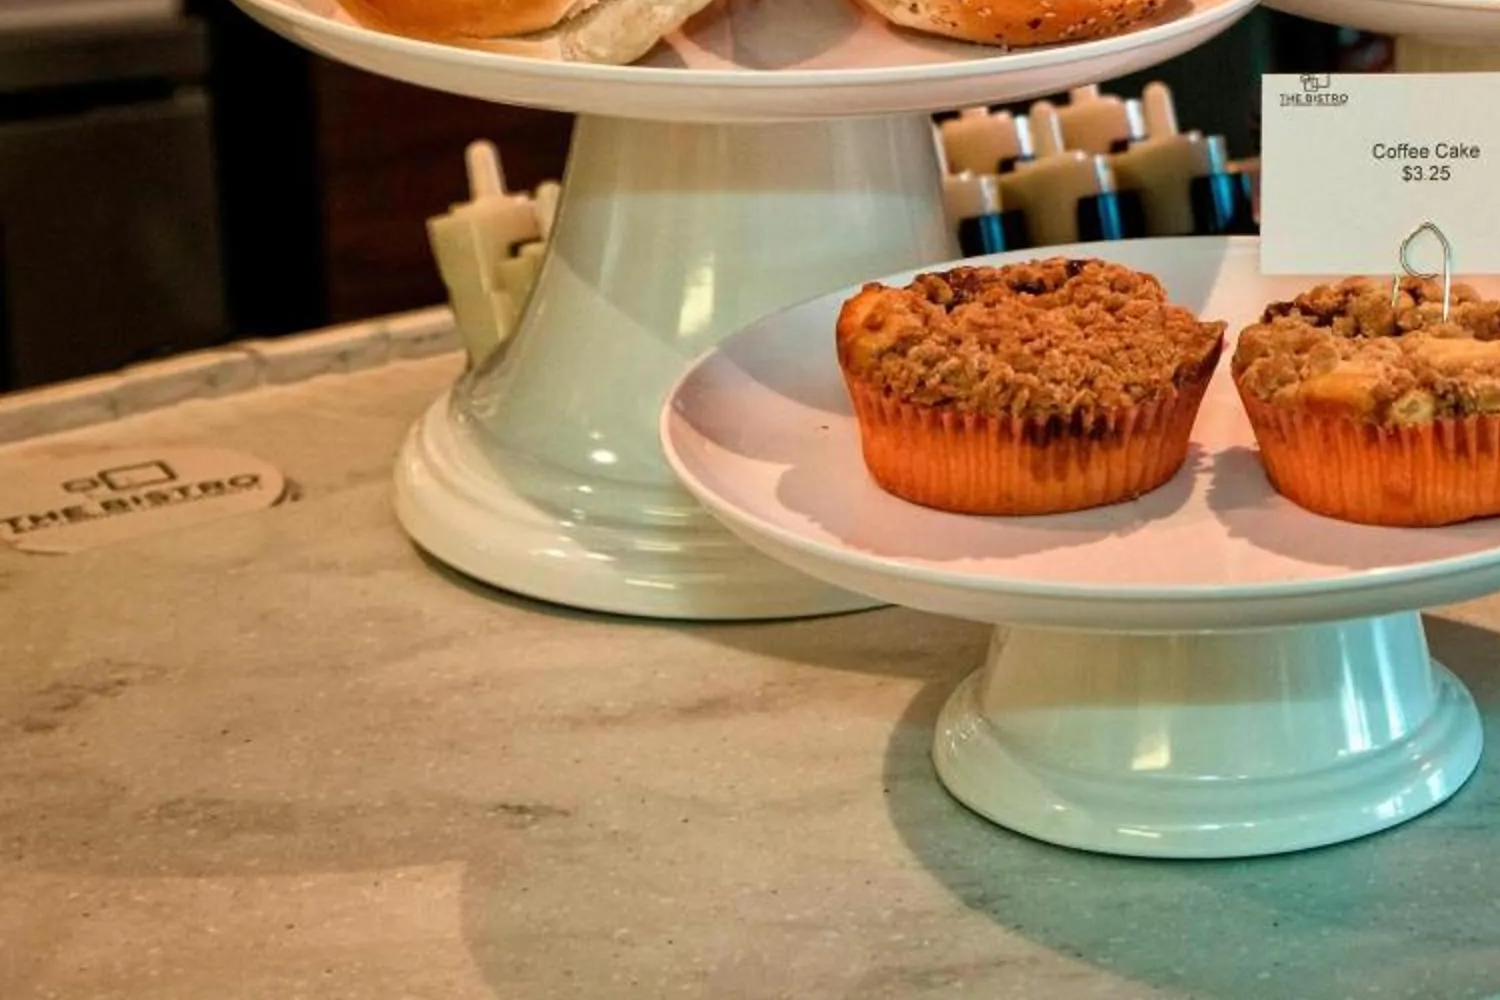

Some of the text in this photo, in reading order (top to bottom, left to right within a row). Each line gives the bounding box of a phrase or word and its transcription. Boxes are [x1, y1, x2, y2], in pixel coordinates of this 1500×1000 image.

[1280, 93, 1349, 106] THE BISTRO
[1372, 142, 1480, 159] Coffee Cake
[1402, 165, 1451, 182] $3.25
[100, 473, 260, 513] BISTRO
